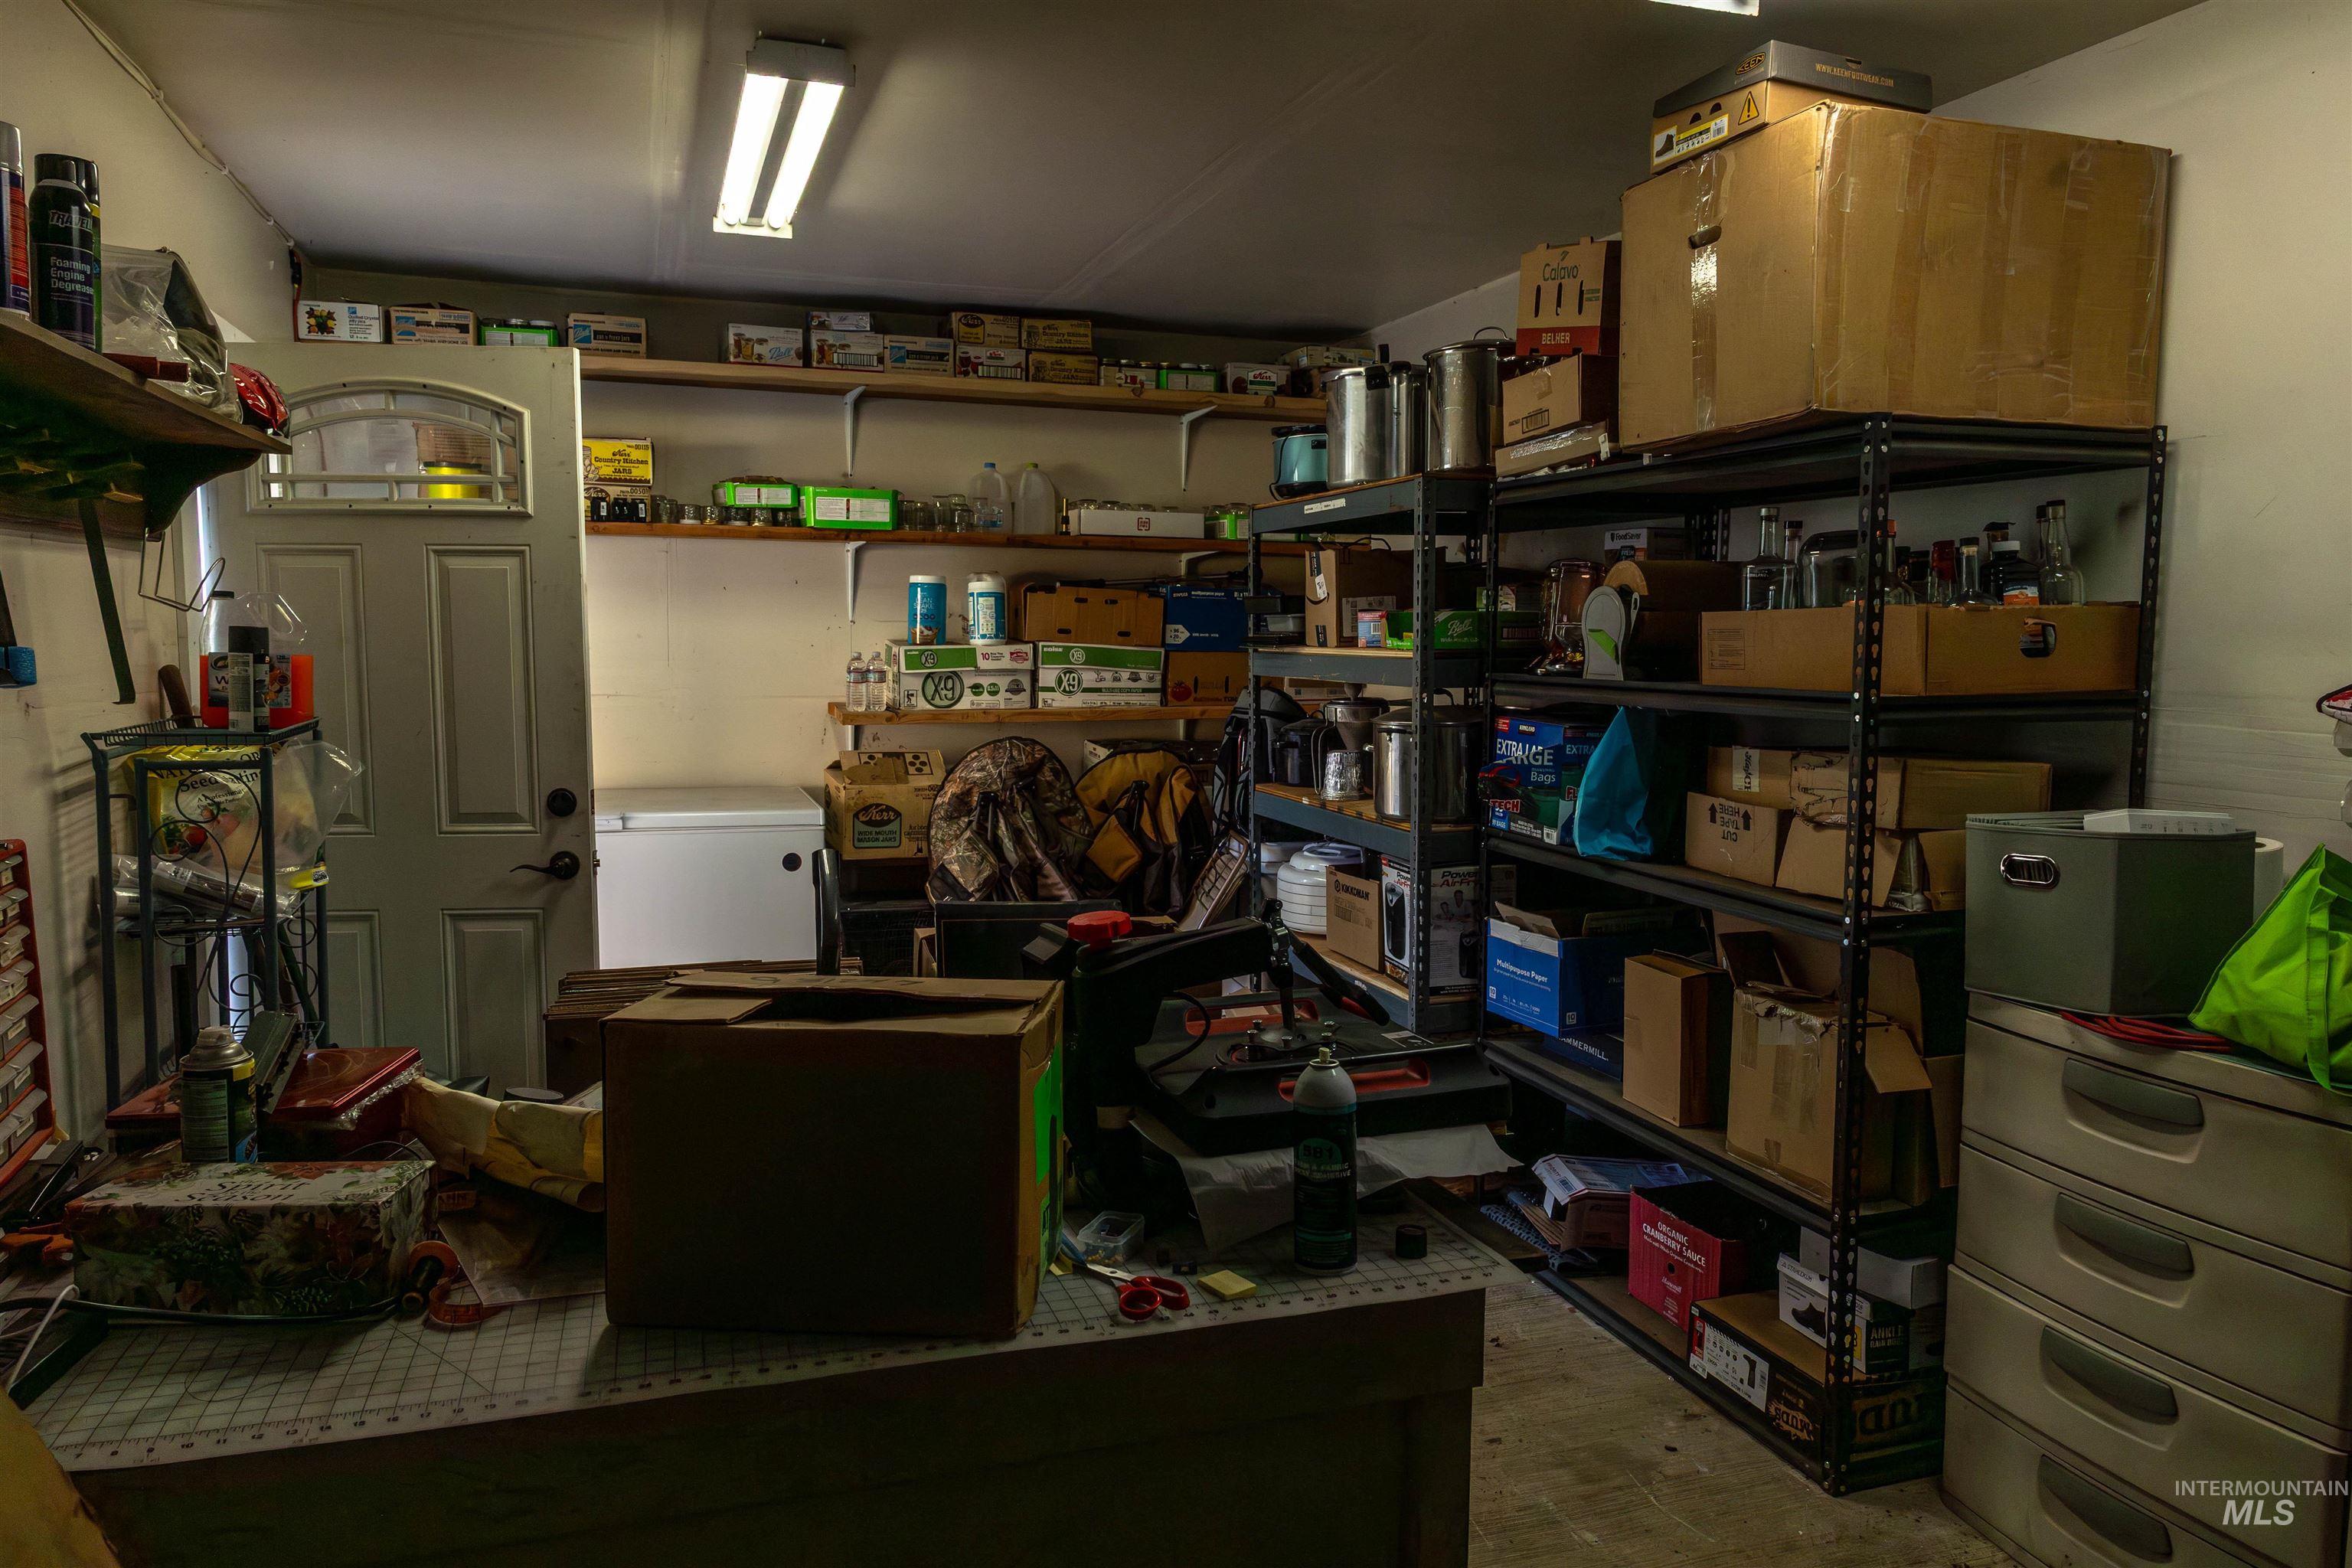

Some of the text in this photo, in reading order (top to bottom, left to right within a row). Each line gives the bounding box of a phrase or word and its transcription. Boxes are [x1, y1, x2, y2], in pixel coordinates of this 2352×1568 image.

[1736, 52, 1766, 74] KEEN
[51, 257, 90, 274] Foaming
[1543, 263, 1579, 281] Calavo
[51, 267, 85, 282] Engine
[1541, 332, 1570, 345] BELHER
[769, 347, 793, 360] Ball
[1253, 371, 1271, 381] Kerr
[622, 457, 648, 466] Kitchen
[1615, 531, 1642, 541] FoodSaver
[1448, 619, 1473, 636] Ball
[981, 652, 990, 661] 10
[1496, 738, 1523, 756] EXTRA
[179, 775, 220, 792] Seed
[1530, 772, 1556, 784] Bags
[858, 805, 896, 822] Kerr
[1489, 799, 1521, 814] TECH
[1718, 803, 1740, 818] HERE
[1720, 816, 1740, 830] TAPE
[1721, 829, 1738, 842] CUT
[1341, 884, 1370, 900] KIKKOMAN
[1497, 958, 1530, 977] Multipurpose
[1530, 970, 1548, 983] Paper
[1658, 1220, 1689, 1246] ORGANIC
[1642, 1223, 1707, 1267] CRANBERRY SAUCE
